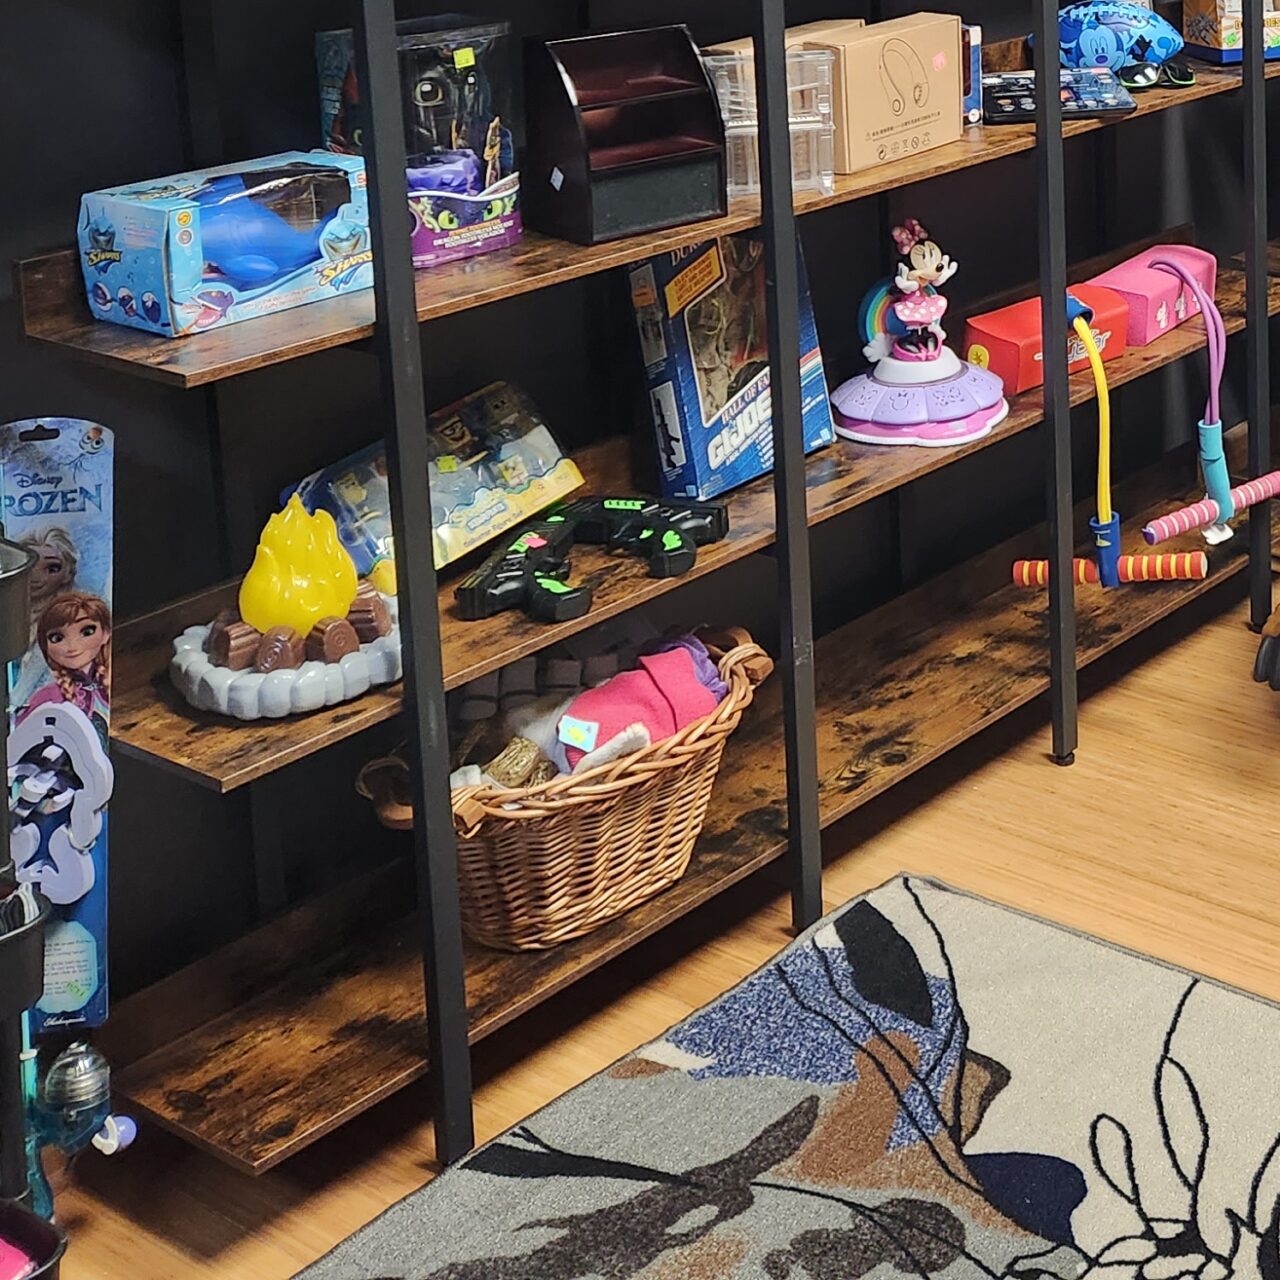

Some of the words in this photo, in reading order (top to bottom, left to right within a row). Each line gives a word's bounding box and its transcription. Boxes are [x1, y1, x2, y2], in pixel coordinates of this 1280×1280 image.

[722, 402, 743, 424] HALL
[743, 387, 757, 406] OF
[13, 472, 63, 489] Disney
